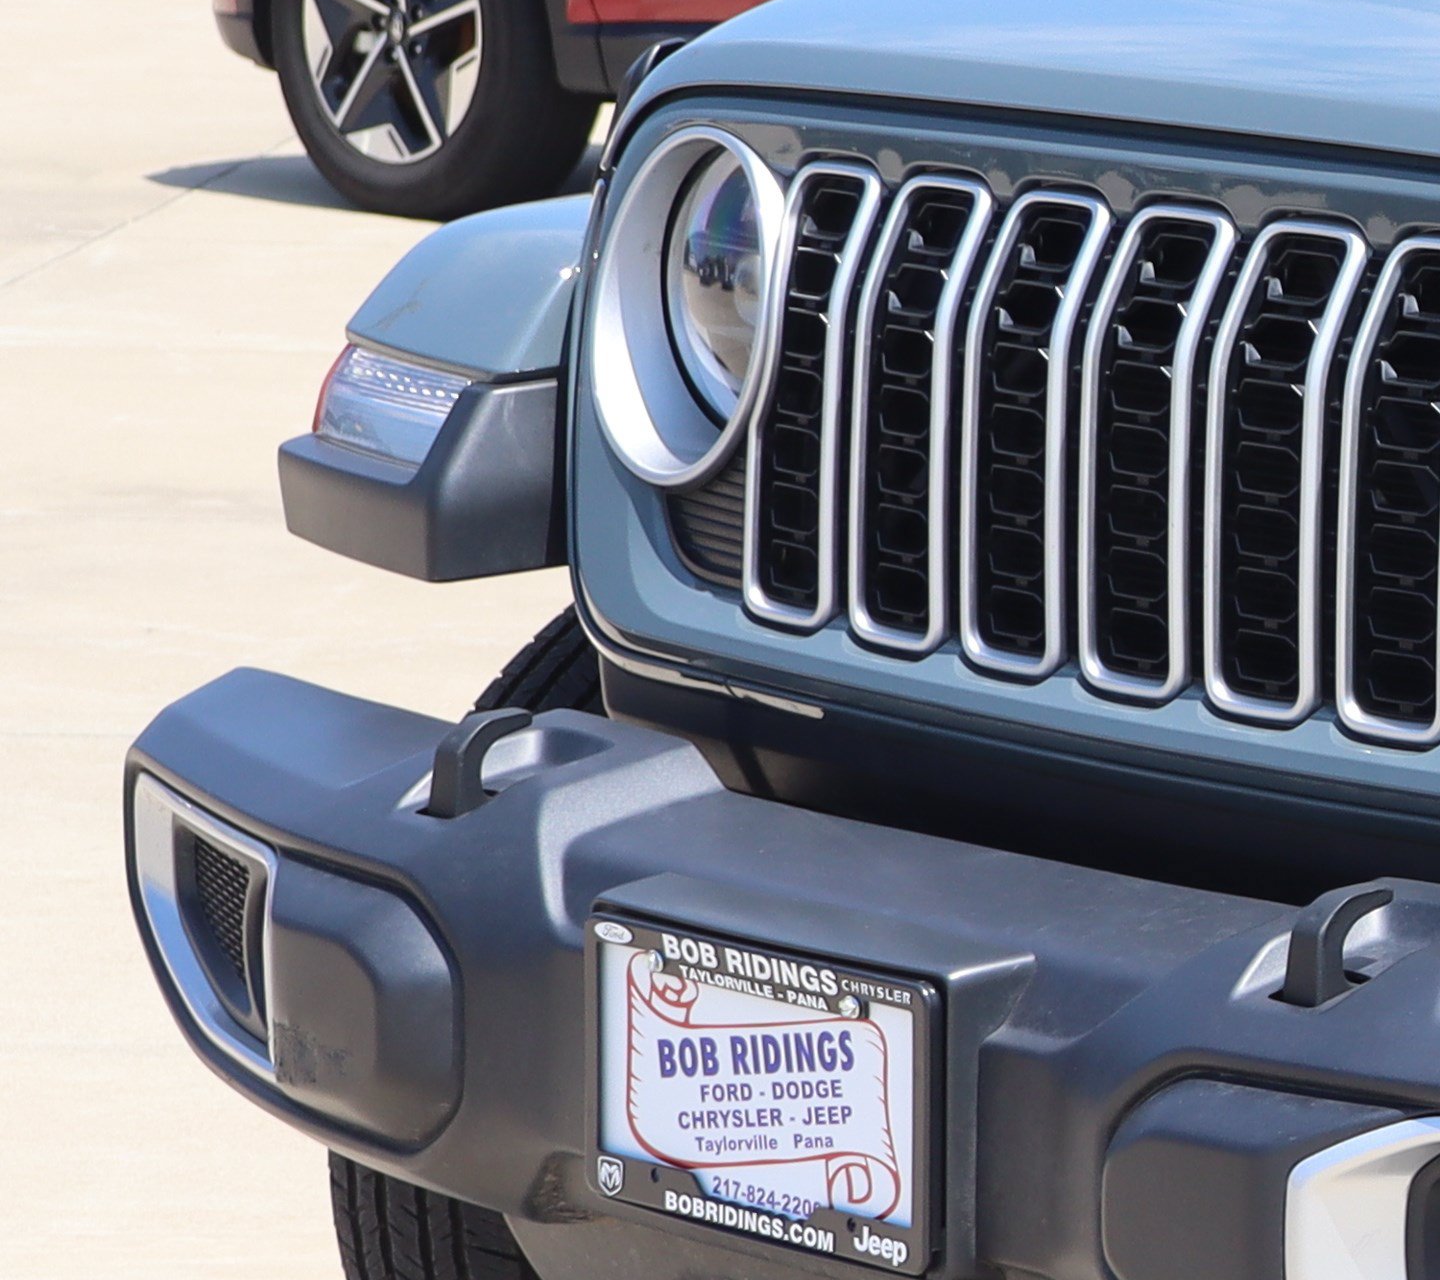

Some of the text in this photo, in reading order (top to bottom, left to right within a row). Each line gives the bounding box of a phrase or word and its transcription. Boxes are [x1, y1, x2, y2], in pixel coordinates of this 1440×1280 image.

[661, 933, 912, 1005] BOB RIDINGS CHRYSLER
[679, 964, 774, 1000] TAYLORVILLE
[787, 989, 828, 1011] PANA
[657, 1030, 855, 1079] BOB RIDINGS
[700, 1082, 753, 1102] FORD
[771, 1079, 843, 1100] DODGE
[677, 1108, 783, 1130] CHRYSLER
[802, 1105, 853, 1126] JEEP
[695, 1132, 834, 1156] Taylorville Pana
[664, 1189, 834, 1253] BOBRIDINGS.COM
[853, 1225, 907, 1266] Jeep
